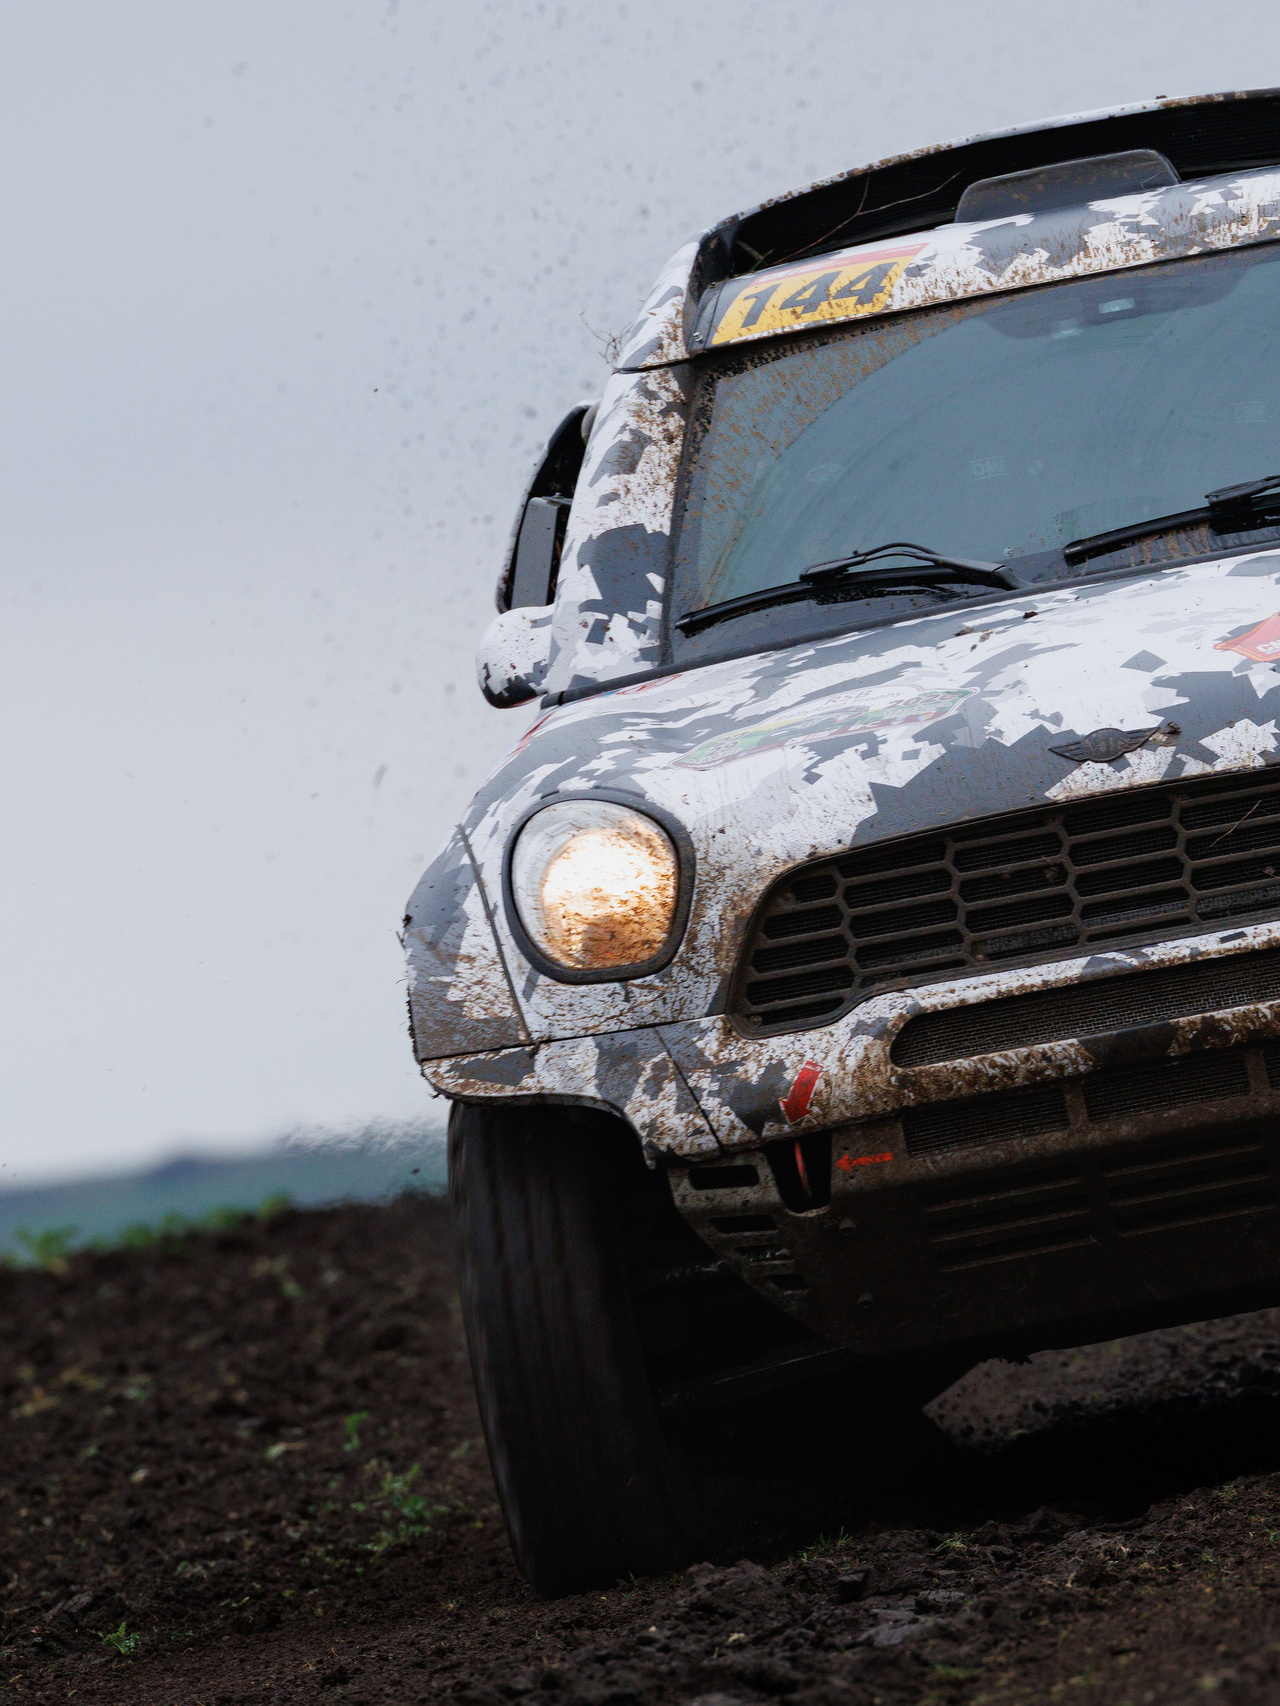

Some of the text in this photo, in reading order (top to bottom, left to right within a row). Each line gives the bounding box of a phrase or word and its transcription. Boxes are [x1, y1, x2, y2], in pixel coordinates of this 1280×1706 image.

[741, 261, 898, 328] 144
[853, 691, 905, 705] Trophy
[884, 692, 958, 709] 2026
